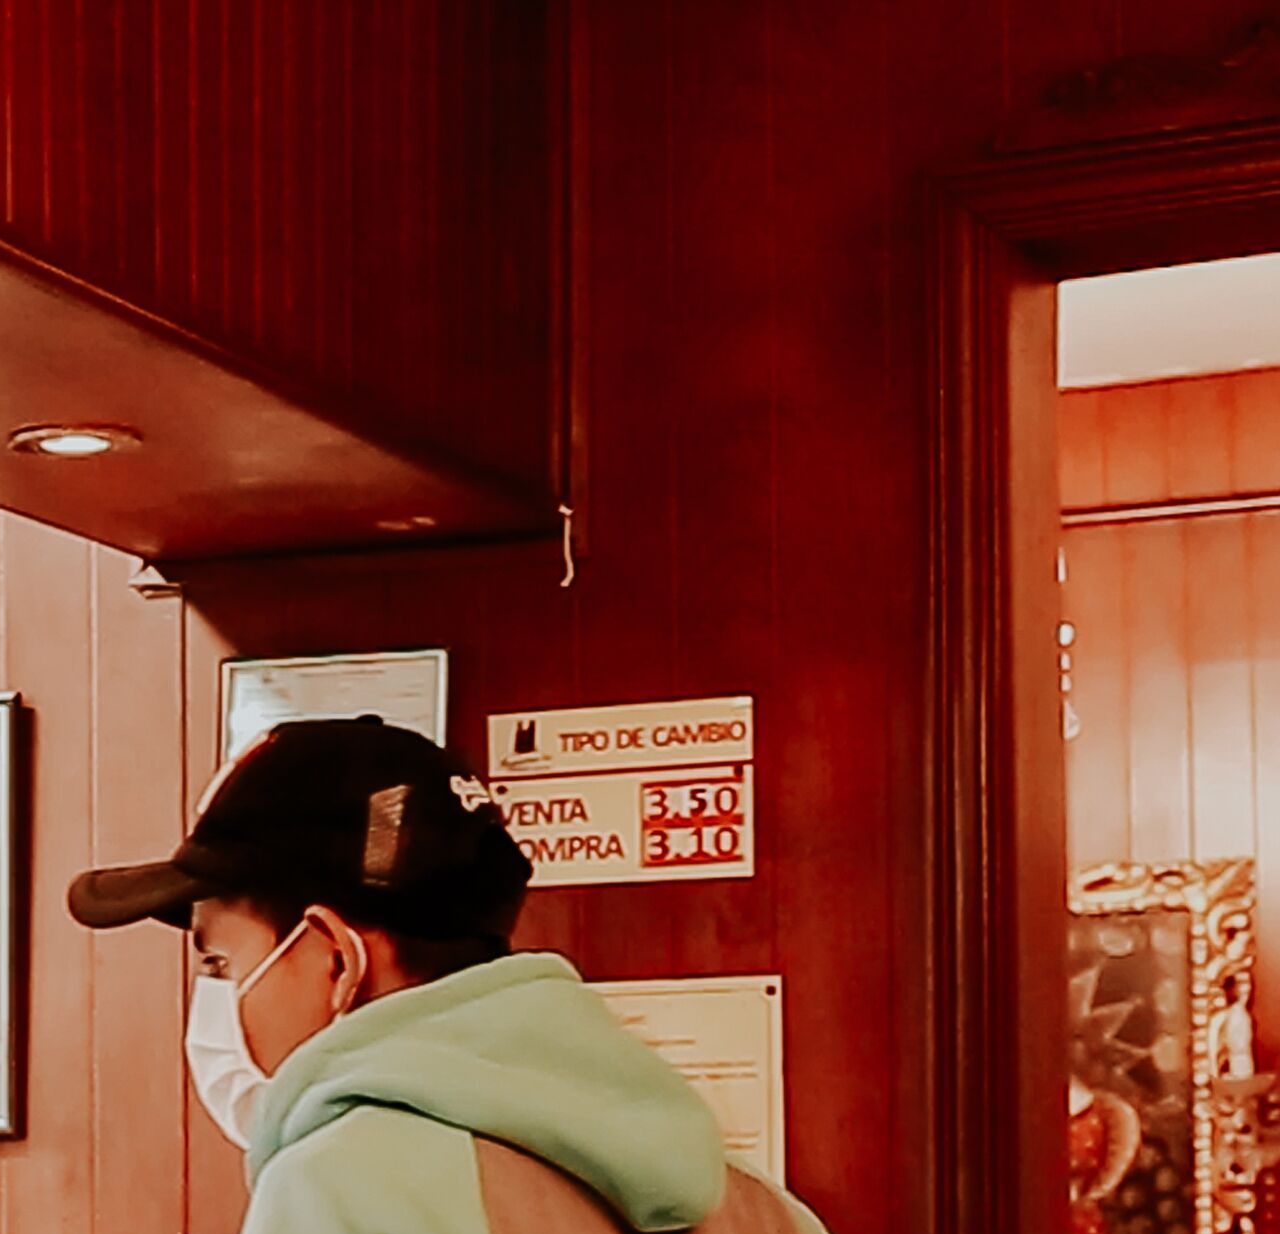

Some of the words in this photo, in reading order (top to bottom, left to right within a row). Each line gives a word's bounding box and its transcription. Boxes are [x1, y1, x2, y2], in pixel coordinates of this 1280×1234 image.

[559, 731, 609, 753] TIPO
[616, 727, 645, 750] DE
[652, 720, 746, 747] CAMBIO
[500, 798, 588, 826] VENTA
[647, 786, 739, 821] 3.50
[517, 834, 625, 863] OMPRA
[647, 826, 739, 862] 3.10
